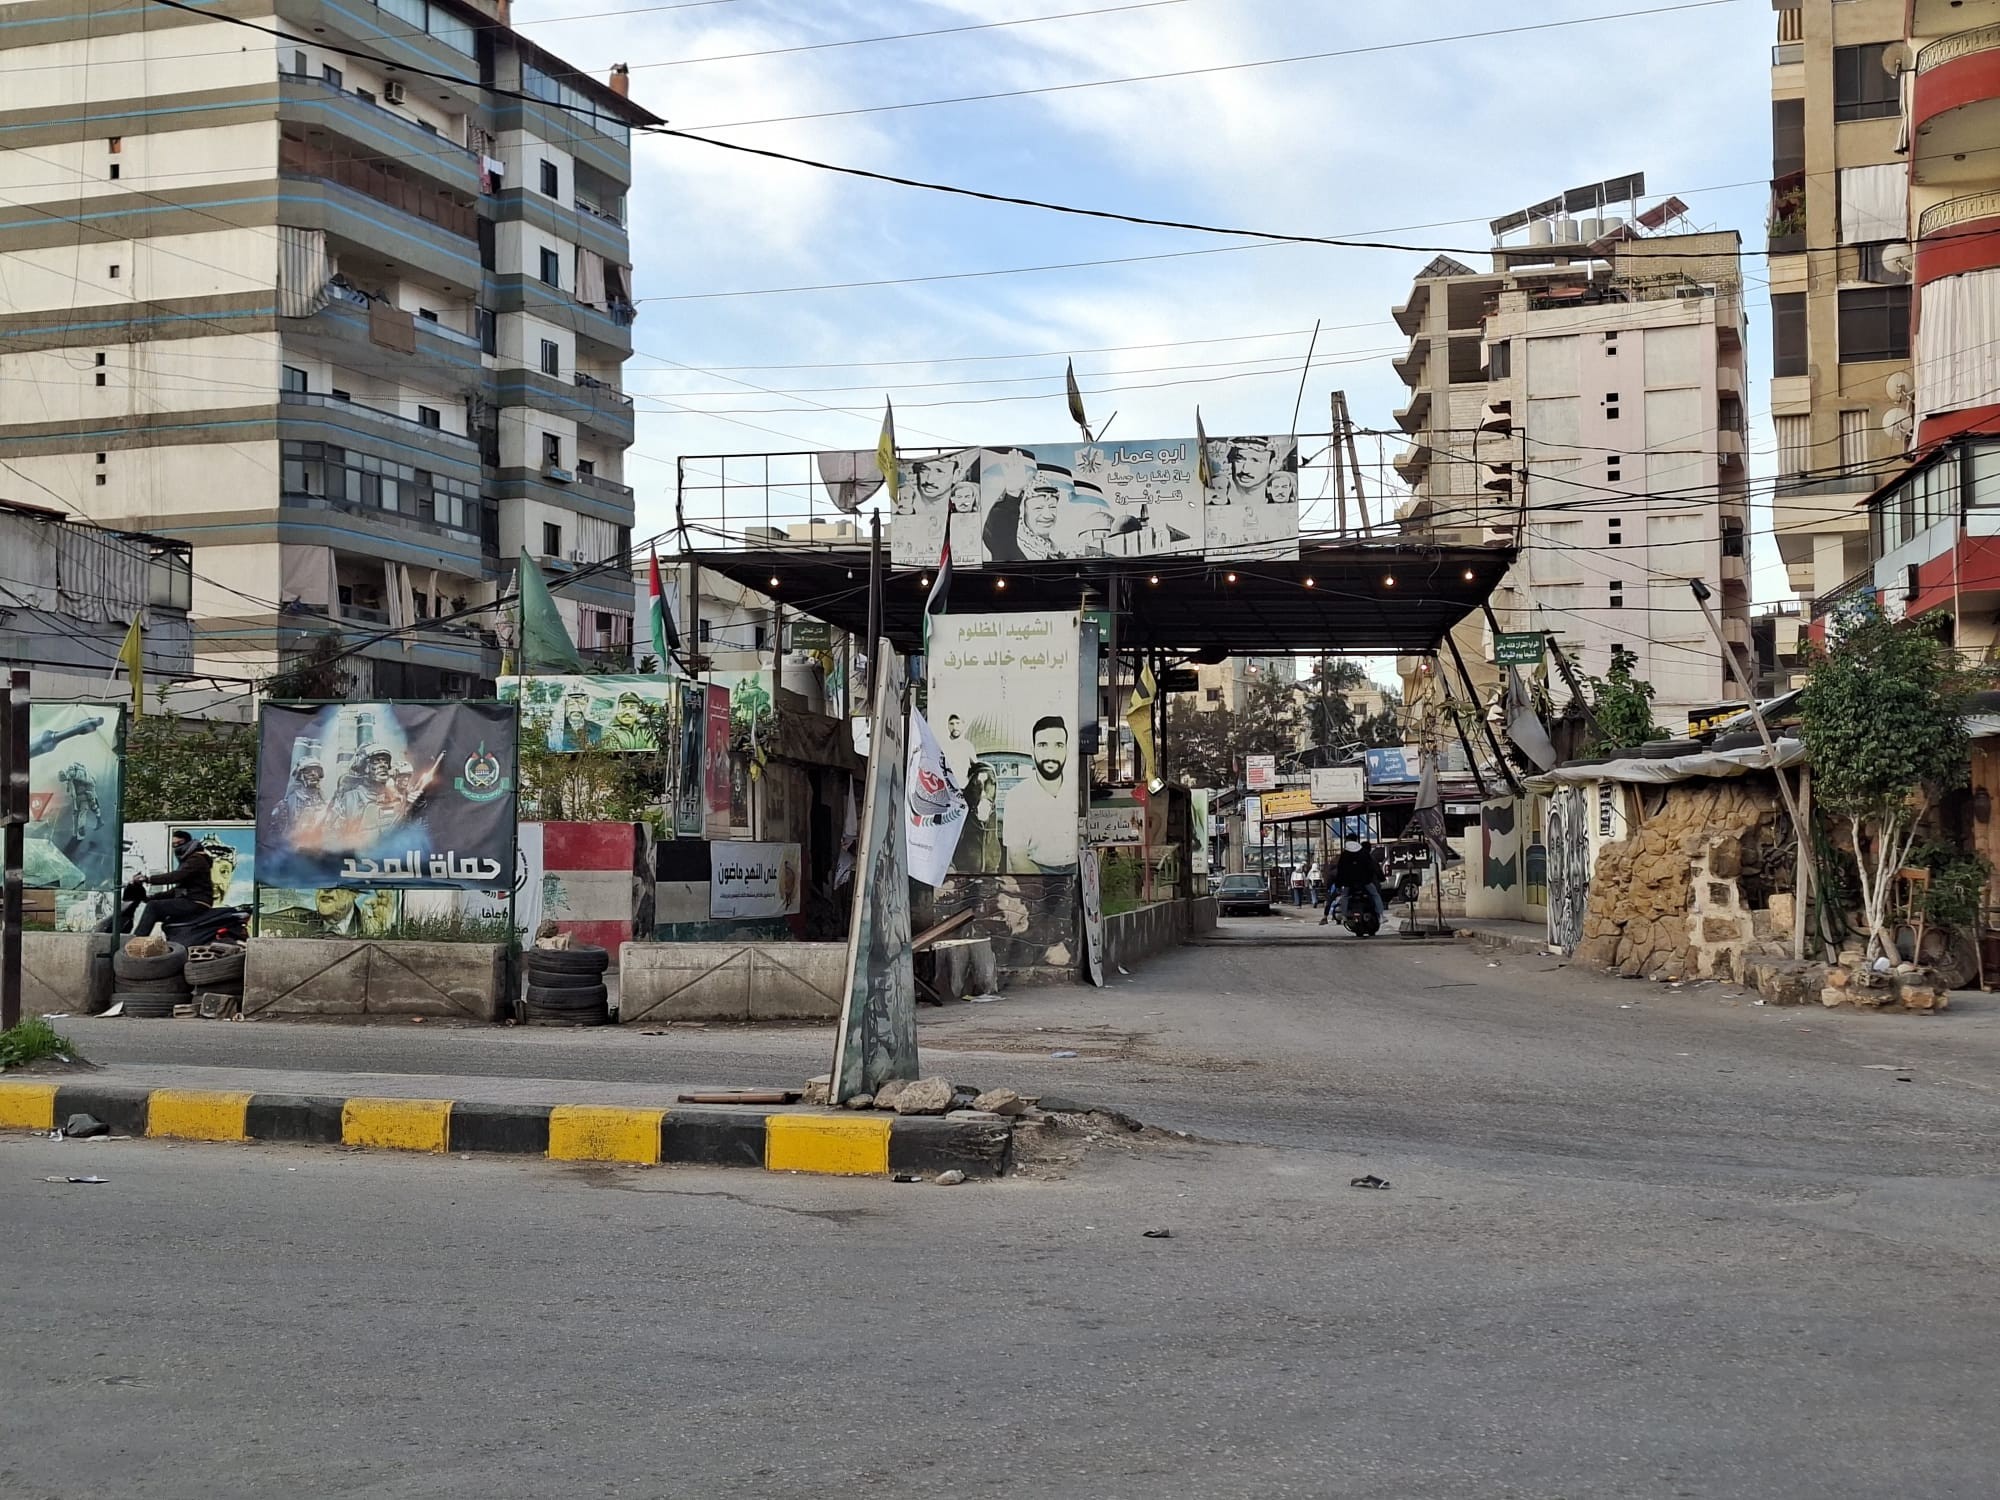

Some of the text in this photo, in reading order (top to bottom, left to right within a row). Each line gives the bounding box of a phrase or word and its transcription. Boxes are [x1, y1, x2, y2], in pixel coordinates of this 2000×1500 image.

[1111, 447, 1154, 467] عمار
[958, 617, 1053, 643] الشهيد المظلوم
[943, 650, 979, 670] عارف
[983, 649, 1015, 666] خالد
[340, 850, 422, 885] المجد
[429, 850, 501, 880] حماة
[1392, 848, 1427, 865] قف حاجز
[718, 862, 777, 889] على النهج ماضون
